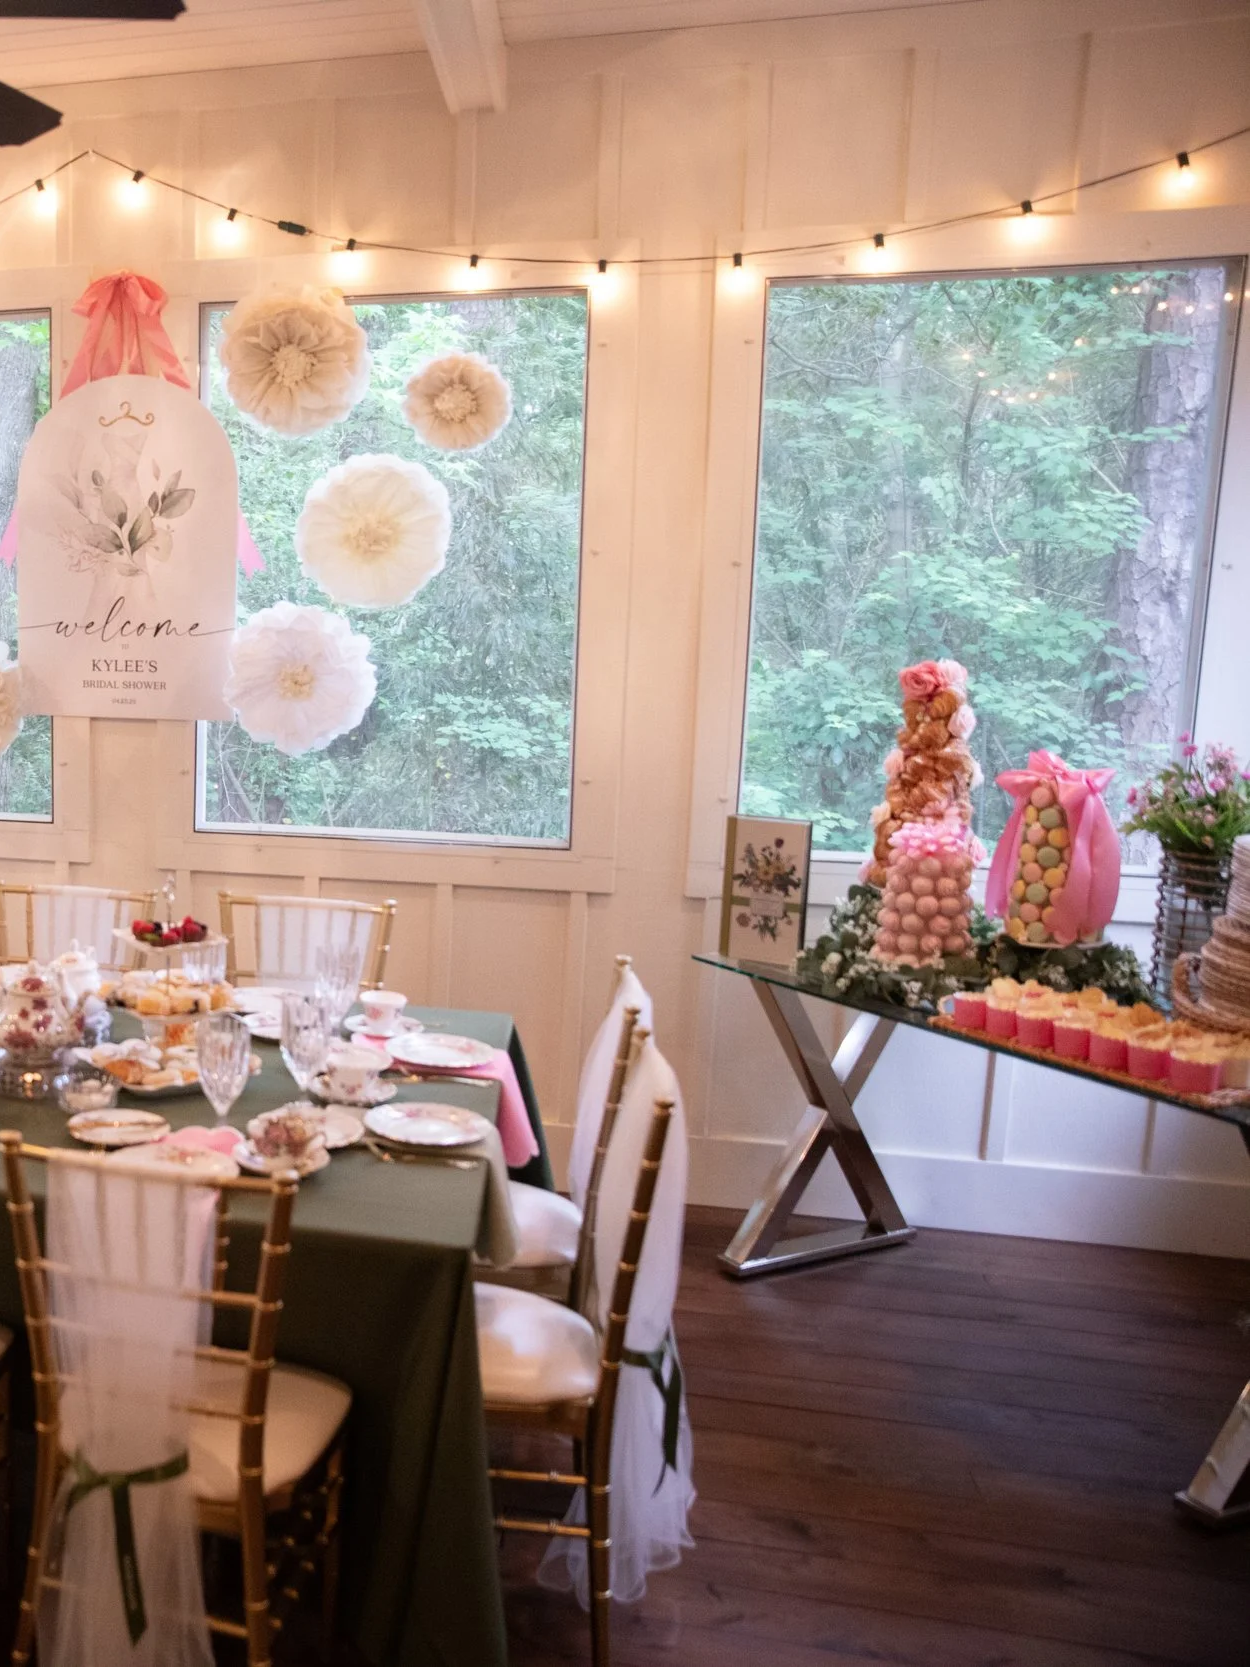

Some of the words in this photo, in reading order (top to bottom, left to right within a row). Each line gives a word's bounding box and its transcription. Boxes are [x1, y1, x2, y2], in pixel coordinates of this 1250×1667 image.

[18, 596, 235, 642] welcome
[92, 659, 158, 673] KYLEE'S
[82, 680, 119, 689] BRIDAL
[122, 681, 167, 690] SHOWER
